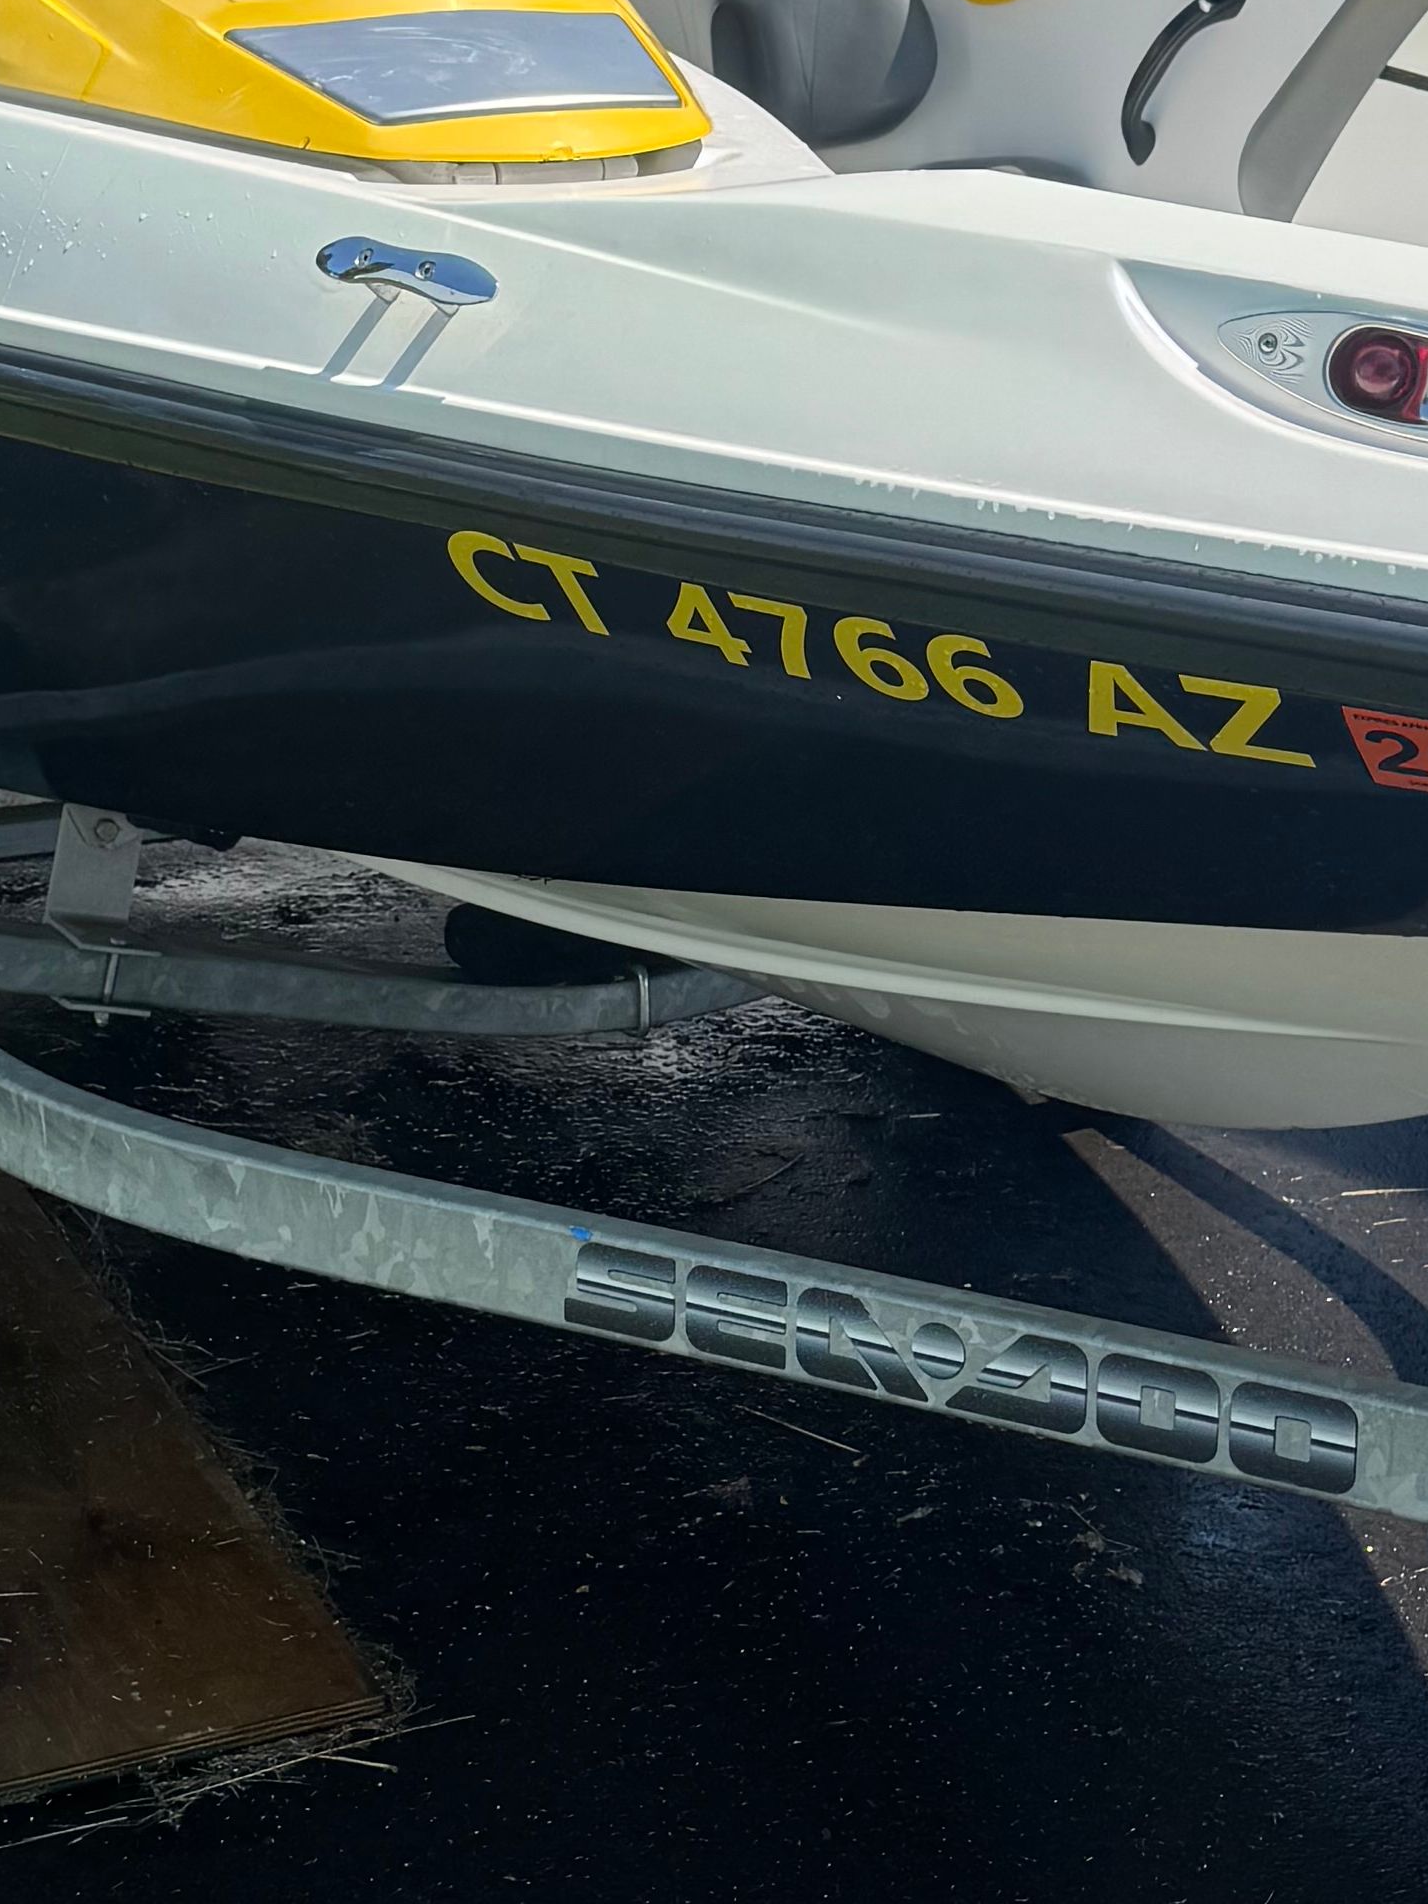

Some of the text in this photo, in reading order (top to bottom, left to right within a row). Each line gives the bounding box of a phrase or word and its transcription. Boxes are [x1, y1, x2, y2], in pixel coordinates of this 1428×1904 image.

[447, 530, 1316, 769] CT 4766 AZ
